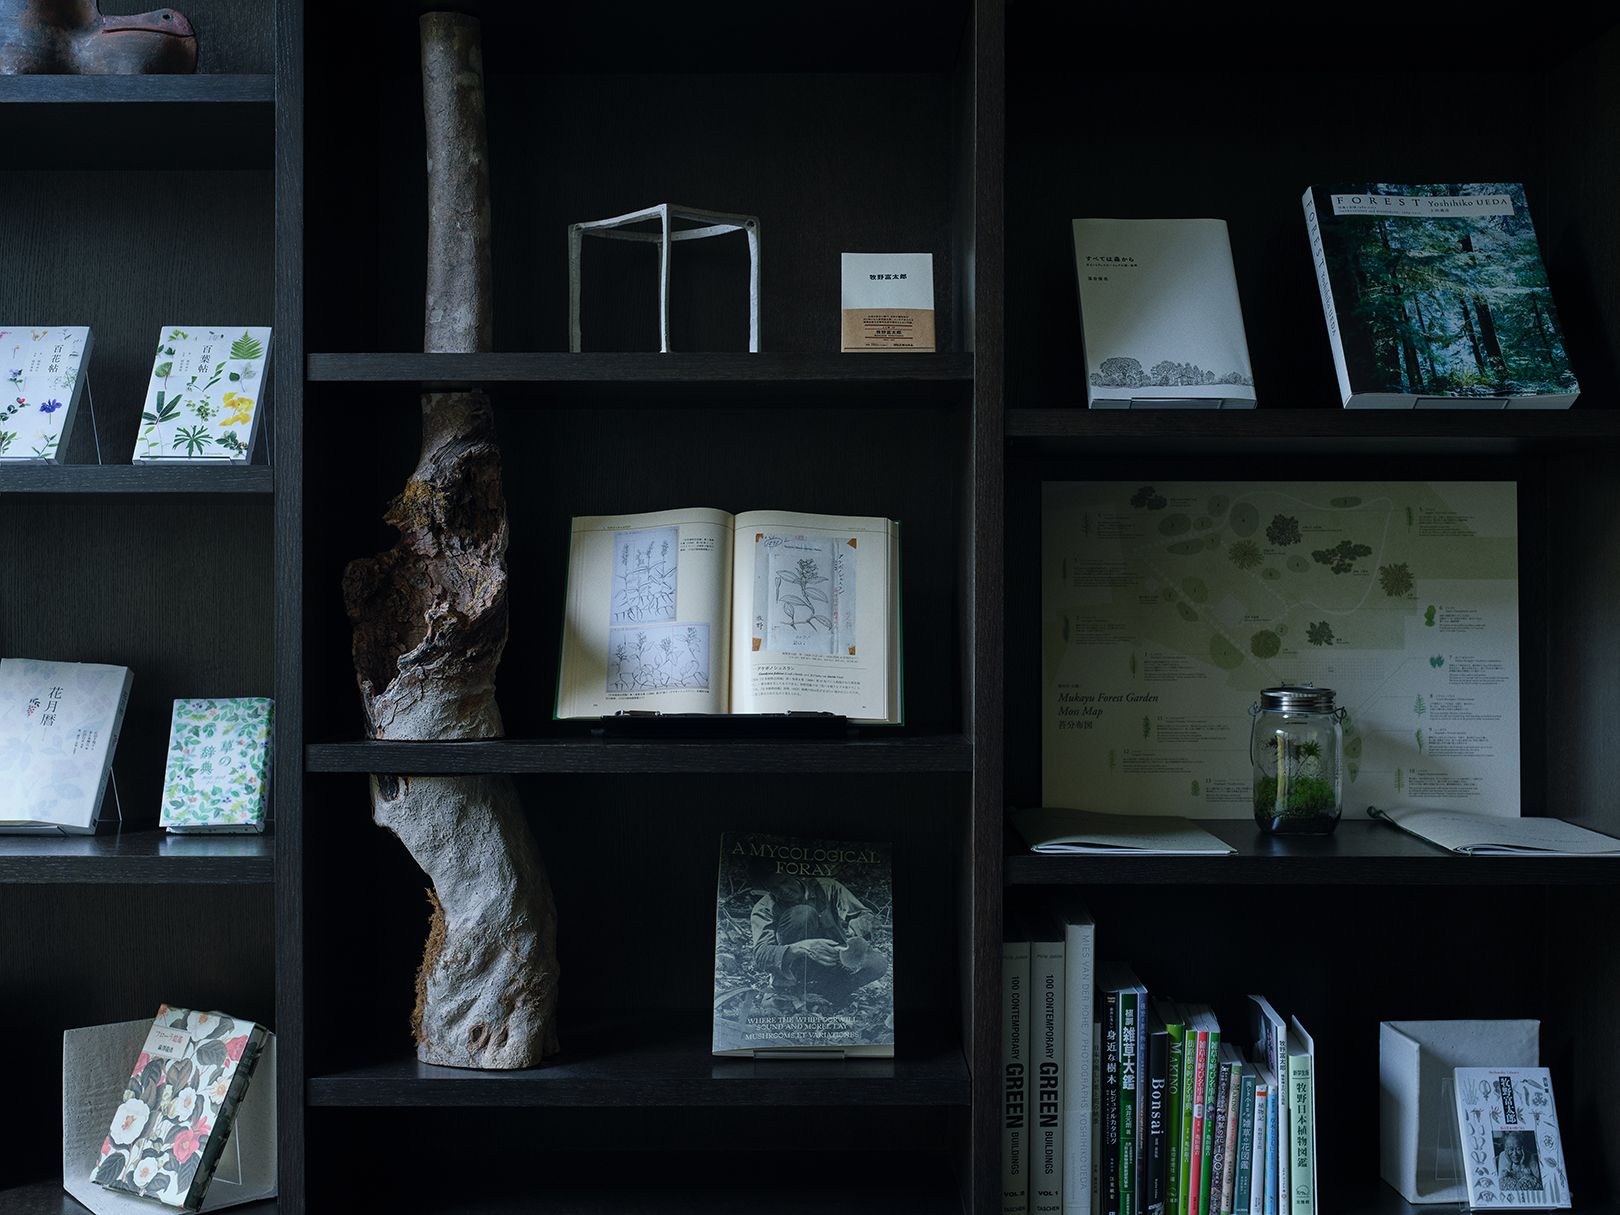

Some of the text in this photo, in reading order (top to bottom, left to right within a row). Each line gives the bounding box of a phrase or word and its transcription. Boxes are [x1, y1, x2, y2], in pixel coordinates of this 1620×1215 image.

[1336, 196, 1508, 208] FOREST Yoshihiko UEDA
[1305, 200, 1326, 269] FOREST
[869, 273, 908, 281] 牧野富太郎
[40, 686, 64, 727] 花月暦
[1057, 692, 1159, 705] Mukayu Forest Garden
[1057, 706, 1103, 719] Moss Map
[1057, 720, 1093, 730] 苔分布図
[199, 745, 216, 776] 辞典
[218, 739, 235, 768] 草の
[731, 842, 881, 864] A MYCOLOGICAL
[775, 861, 837, 876] FORAY
[1082, 934, 1090, 959] MIES
[1082, 960, 1090, 981] VAN
[1082, 984, 1090, 1003] DER
[1082, 1004, 1090, 1028] ROHE
[745, 1032, 796, 1040] MUSHROOMS
[1106, 1030, 1118, 1085] 身近な樹木
[1122, 1026, 1136, 1091] 雑草大鑑
[1168, 1040, 1183, 1095] MAKINO
[1278, 1040, 1287, 1071] 牧野富太郎
[1005, 976, 1025, 1175] 100 CONTEMPORARY GREEN BUILDINGS
[1038, 974, 1059, 1175] 100 CONTEMPORARY GREEN BUILDINGS
[1081, 1038, 1089, 1109] PHOTOGRAPHS
[1151, 1077, 1166, 1137] Bonsai
[1230, 1083, 1240, 1113] MAKINO
[1109, 1088, 1118, 1145] ビジュアルカタログ
[1295, 1081, 1309, 1169] 牧野日本植物図鑑
[1080, 1112, 1088, 1163] YOSHIHIKO
[1080, 1164, 1088, 1191] UEDA
